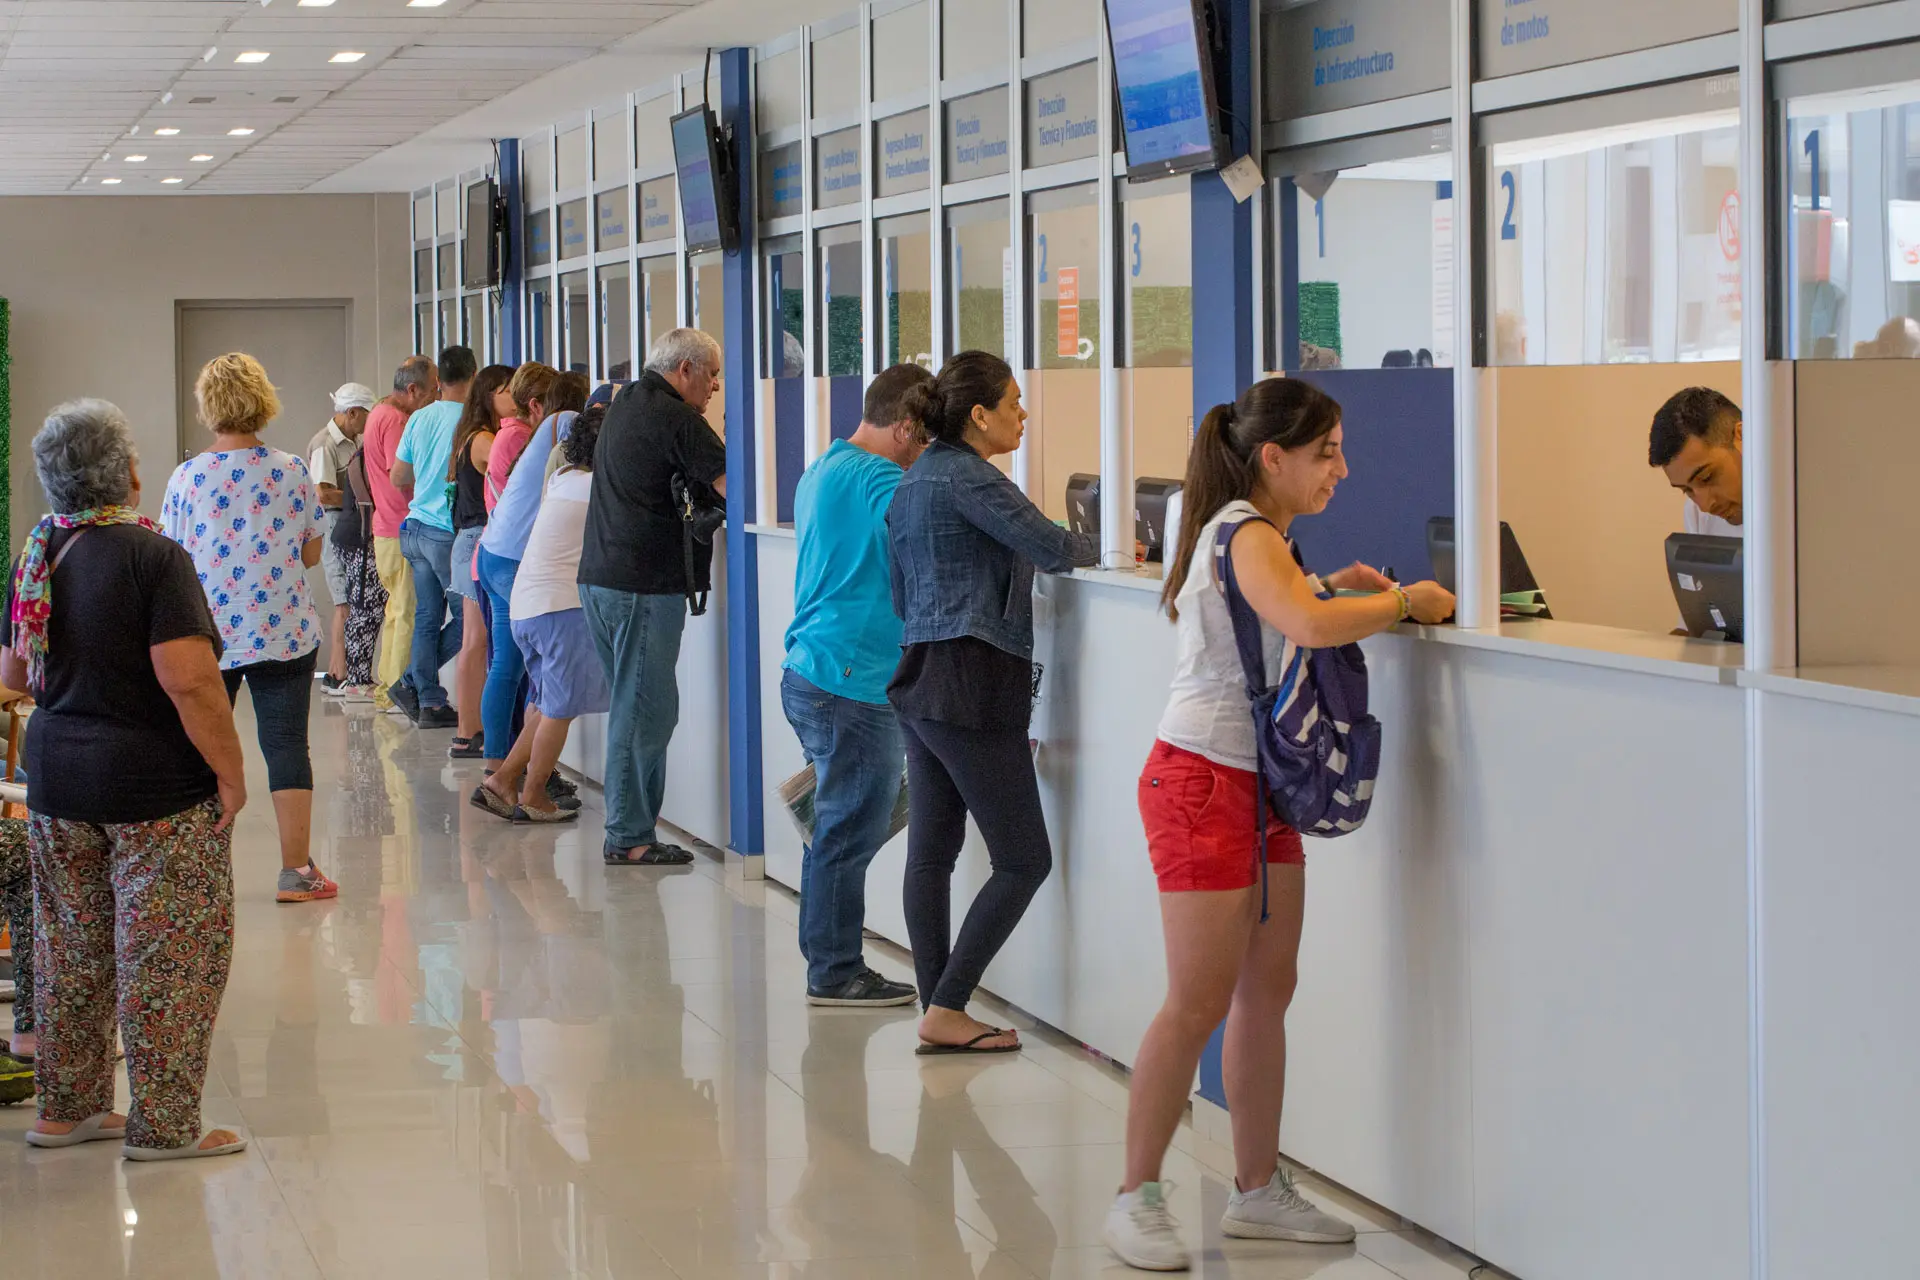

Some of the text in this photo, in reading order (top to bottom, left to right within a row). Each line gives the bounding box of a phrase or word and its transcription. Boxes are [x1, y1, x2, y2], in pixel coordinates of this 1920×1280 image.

[1313, 18, 1355, 51] Dirección
[1501, 13, 1549, 46] de motos
[1314, 50, 1394, 87] de Infraestructura
[1038, 91, 1066, 118] Dirección
[1039, 122, 1060, 147] Técnica
[1065, 115, 1097, 141] Financiera
[1803, 130, 1820, 211] 1
[1500, 170, 1517, 241] 2
[1131, 221, 1142, 278] 3
[1314, 197, 1326, 259] 1
[1038, 233, 1048, 284] 2
